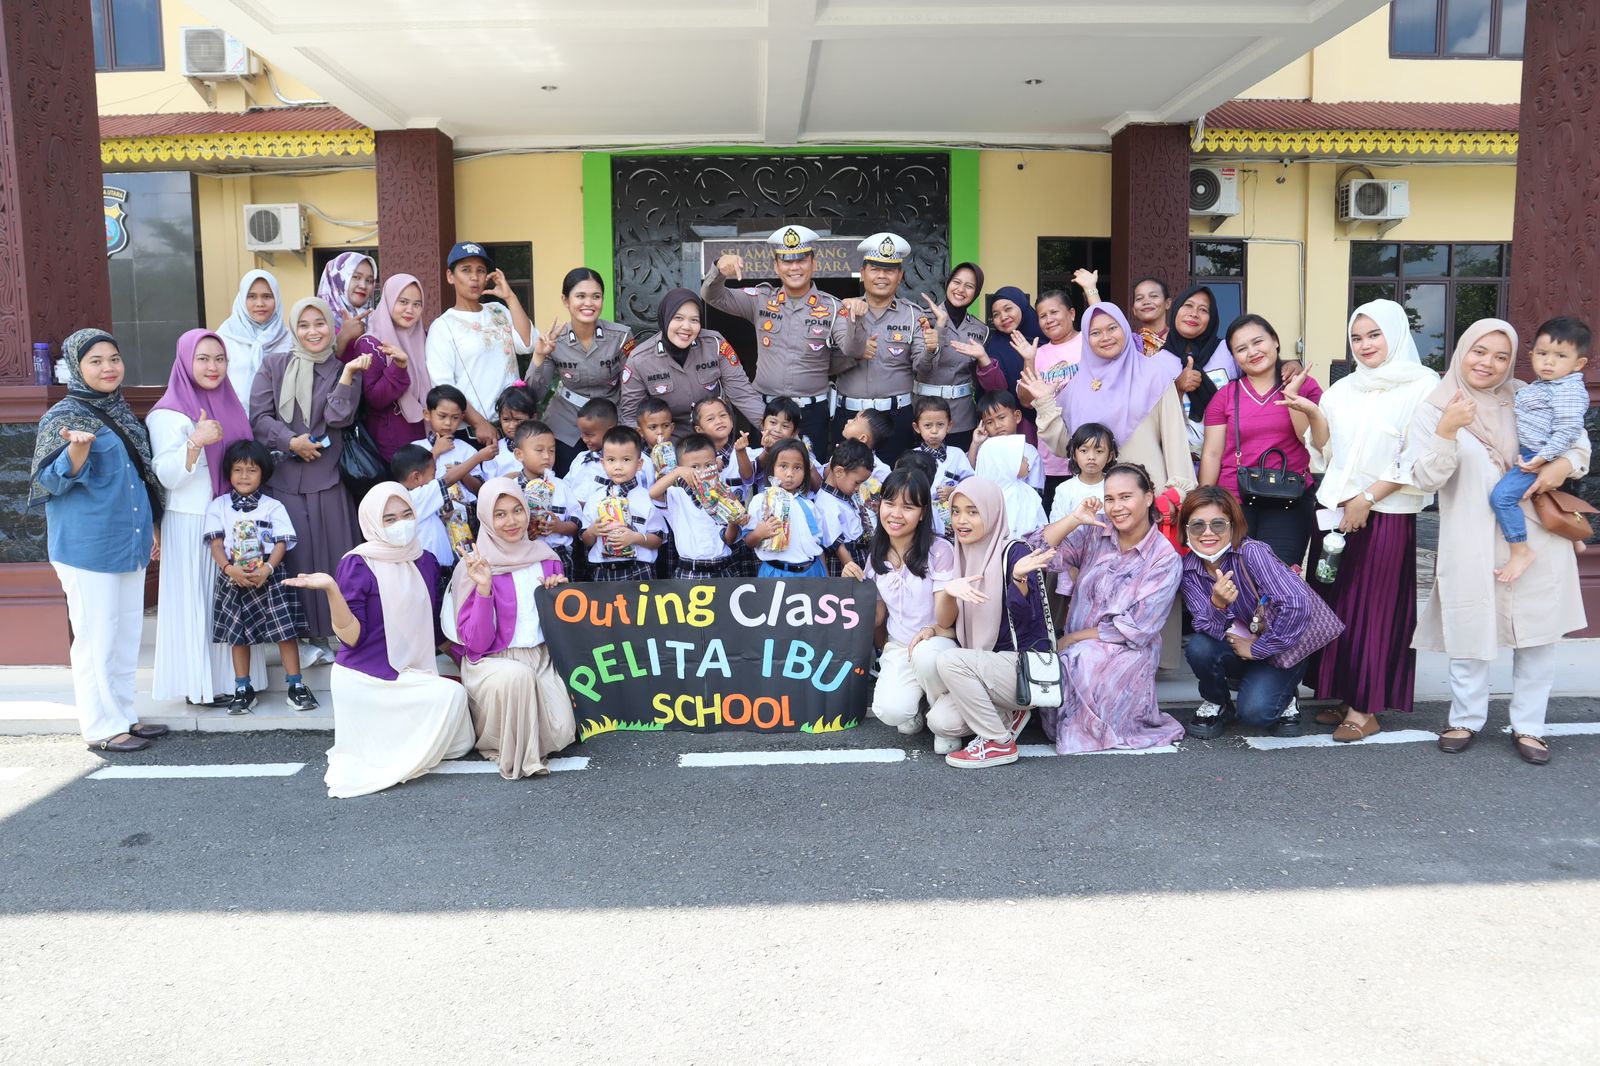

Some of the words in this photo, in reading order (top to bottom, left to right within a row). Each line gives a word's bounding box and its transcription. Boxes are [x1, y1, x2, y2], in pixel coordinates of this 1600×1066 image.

[759, 309, 783, 321] SIMON
[805, 318, 832, 328] POLRI
[695, 360, 719, 371] POLRI
[647, 372, 671, 382] MERLIN
[554, 583, 716, 628] Outing
[729, 580, 860, 630] Class
[569, 638, 732, 702] PELITA
[652, 692, 795, 728] SCHOOL
